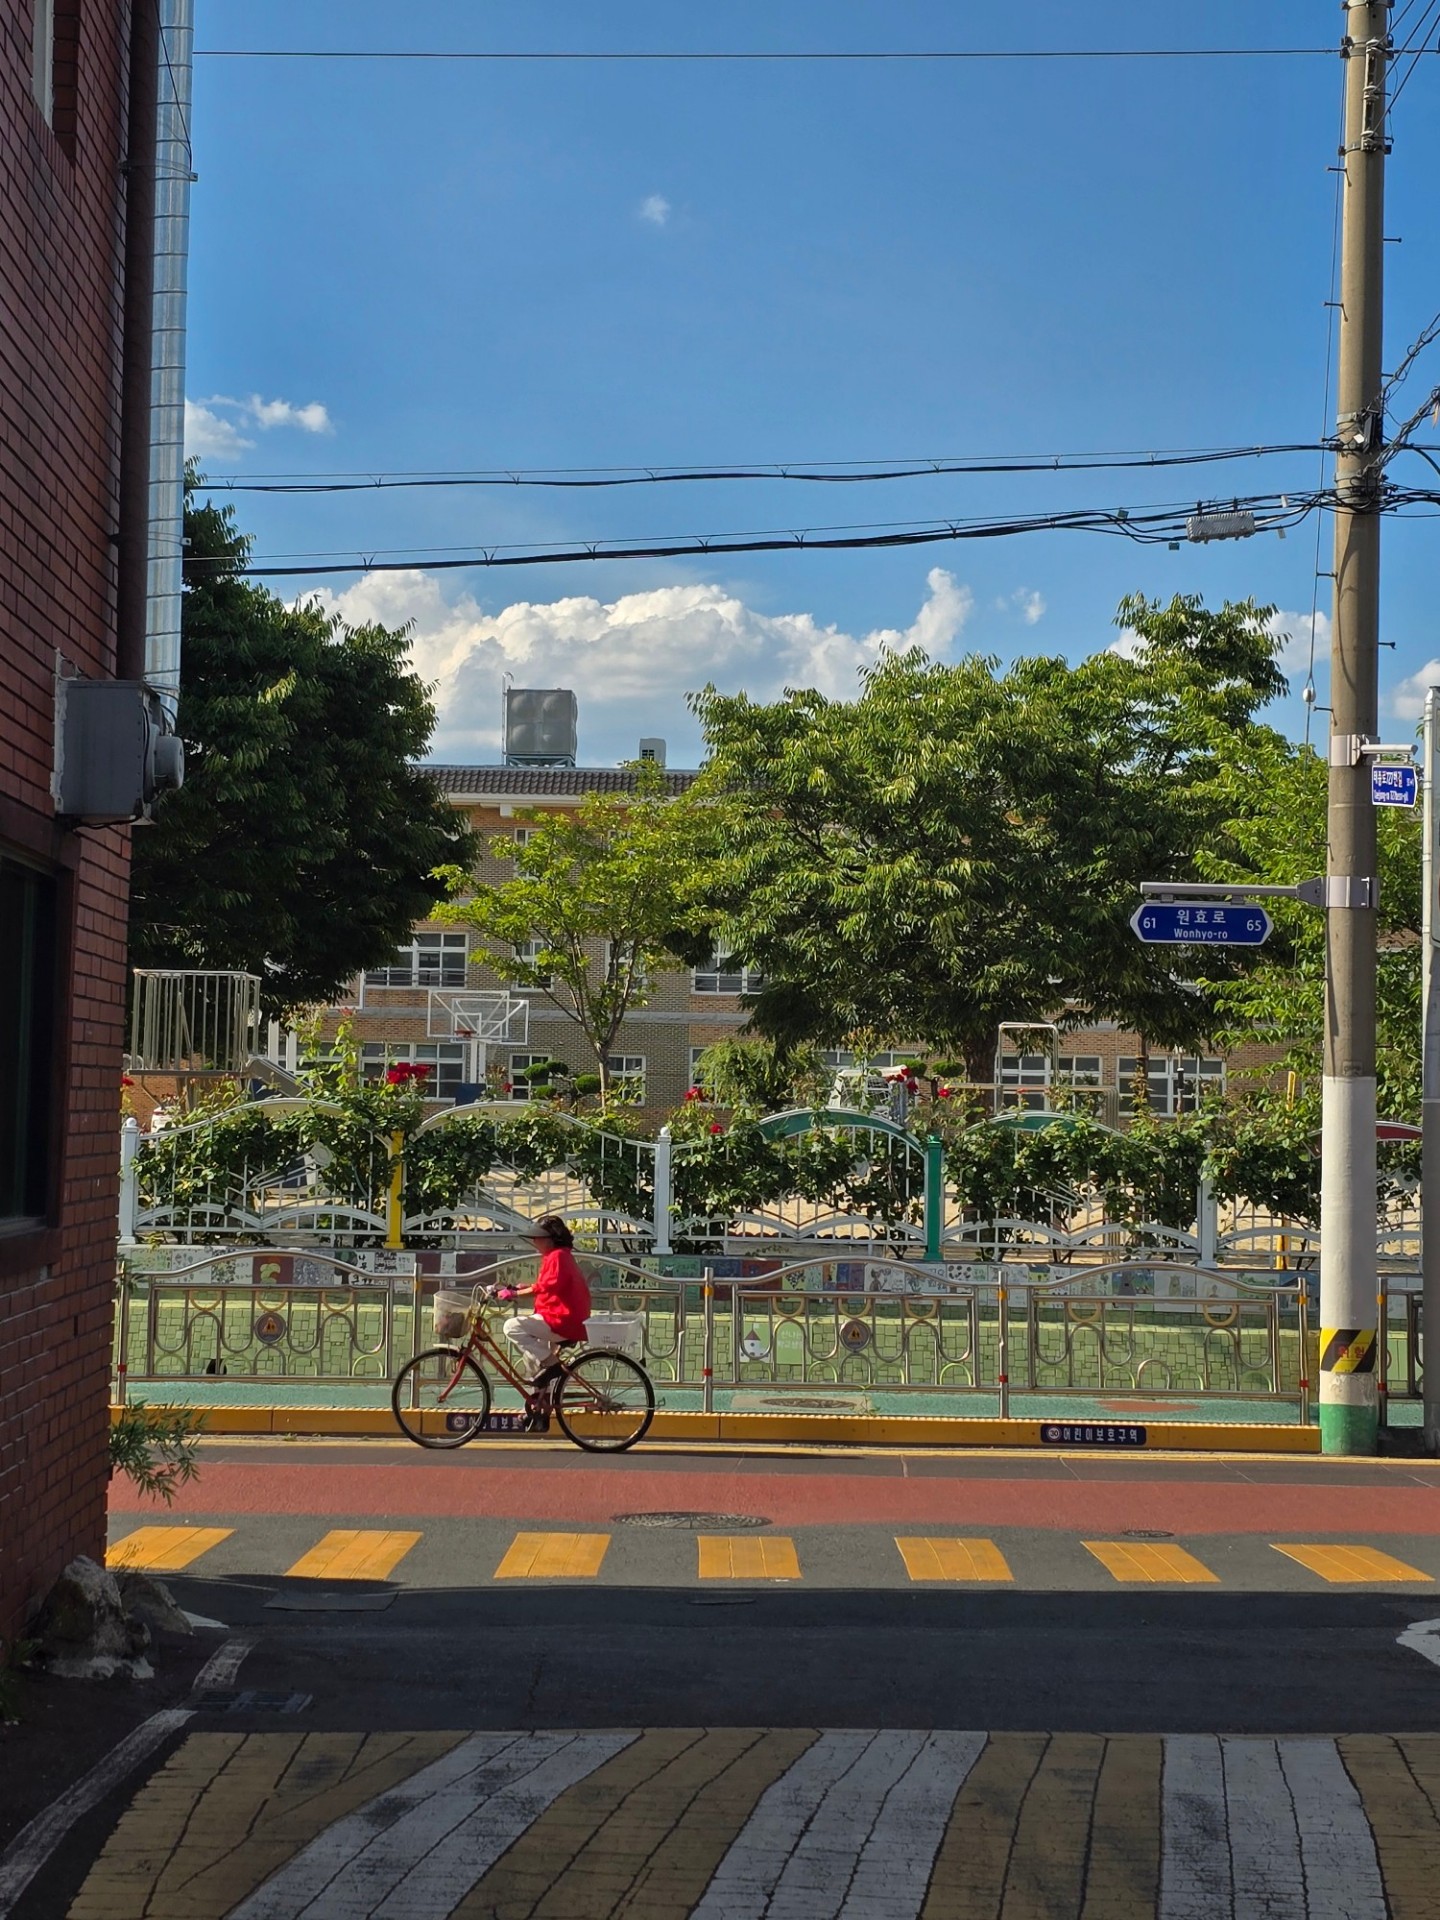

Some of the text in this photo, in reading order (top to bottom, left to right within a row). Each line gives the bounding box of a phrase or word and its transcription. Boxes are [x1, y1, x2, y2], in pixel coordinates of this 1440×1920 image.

[1142, 917, 1157, 929] 61
[1176, 909, 1227, 926] 원효로
[1246, 919, 1262, 931] 65
[1173, 928, 1228, 940] Wonhyo-ro
[1063, 1427, 1137, 1442] 어린이보호구역
